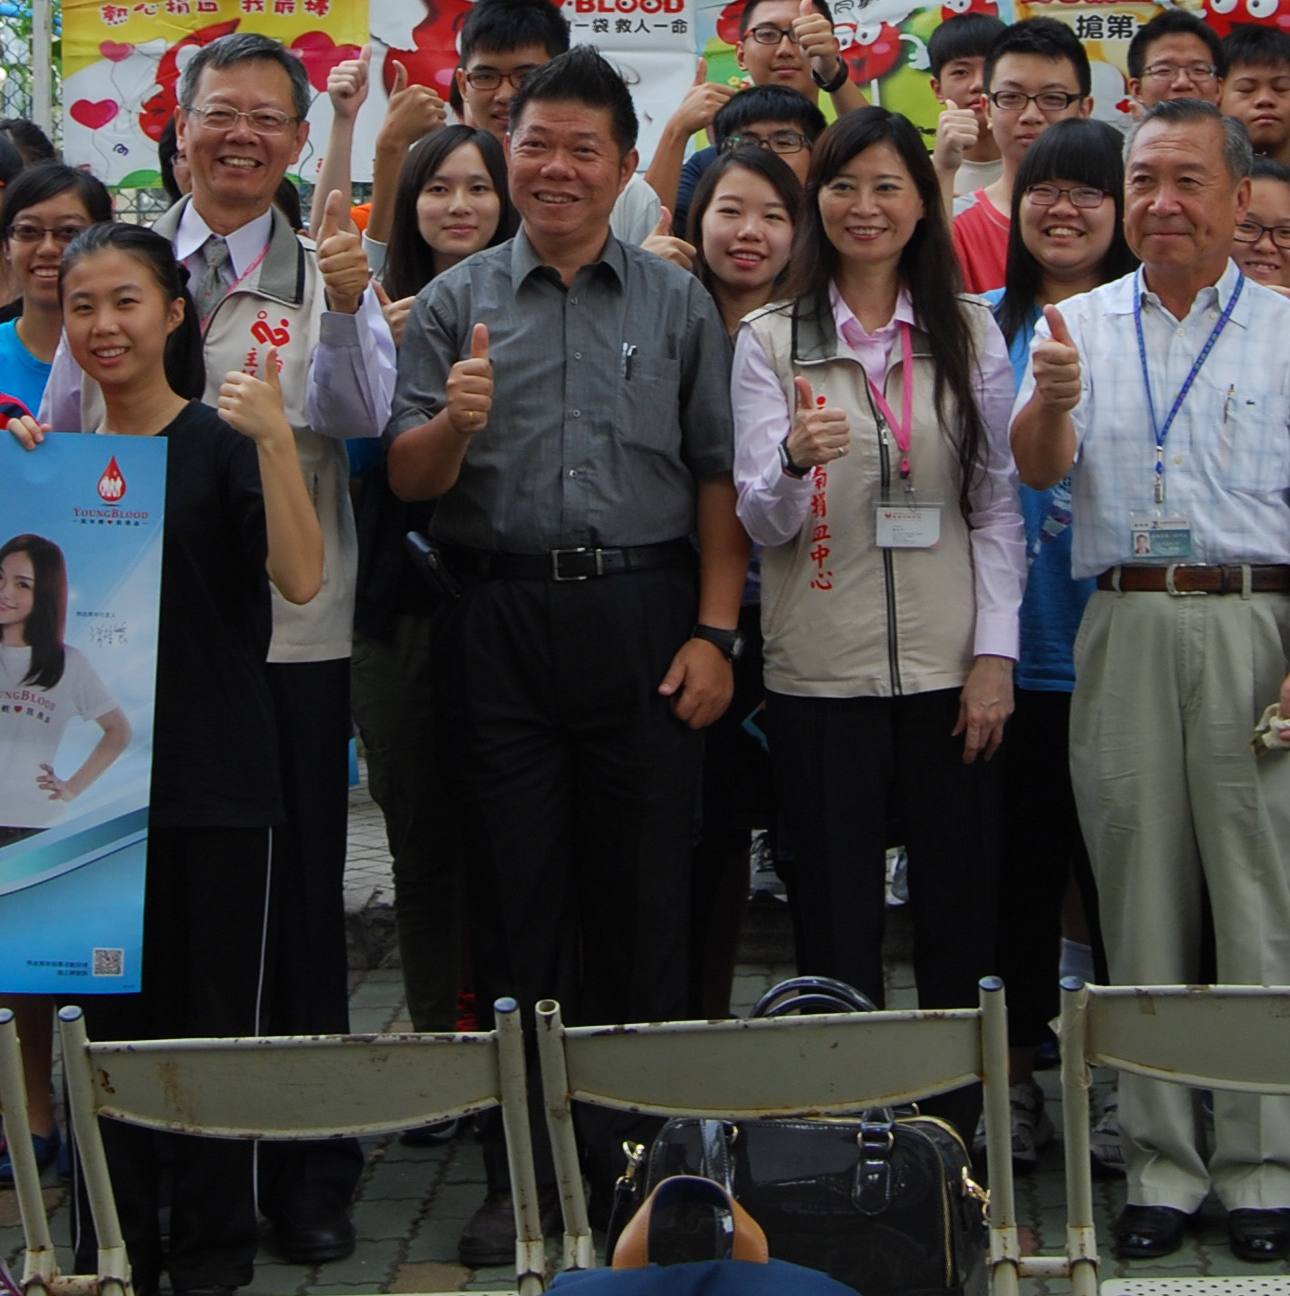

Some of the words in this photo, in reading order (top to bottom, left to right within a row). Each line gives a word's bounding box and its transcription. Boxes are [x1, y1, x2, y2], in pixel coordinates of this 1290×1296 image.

[615, 18, 688, 35] 救人一命
[1076, 14, 1142, 40] 搶第
